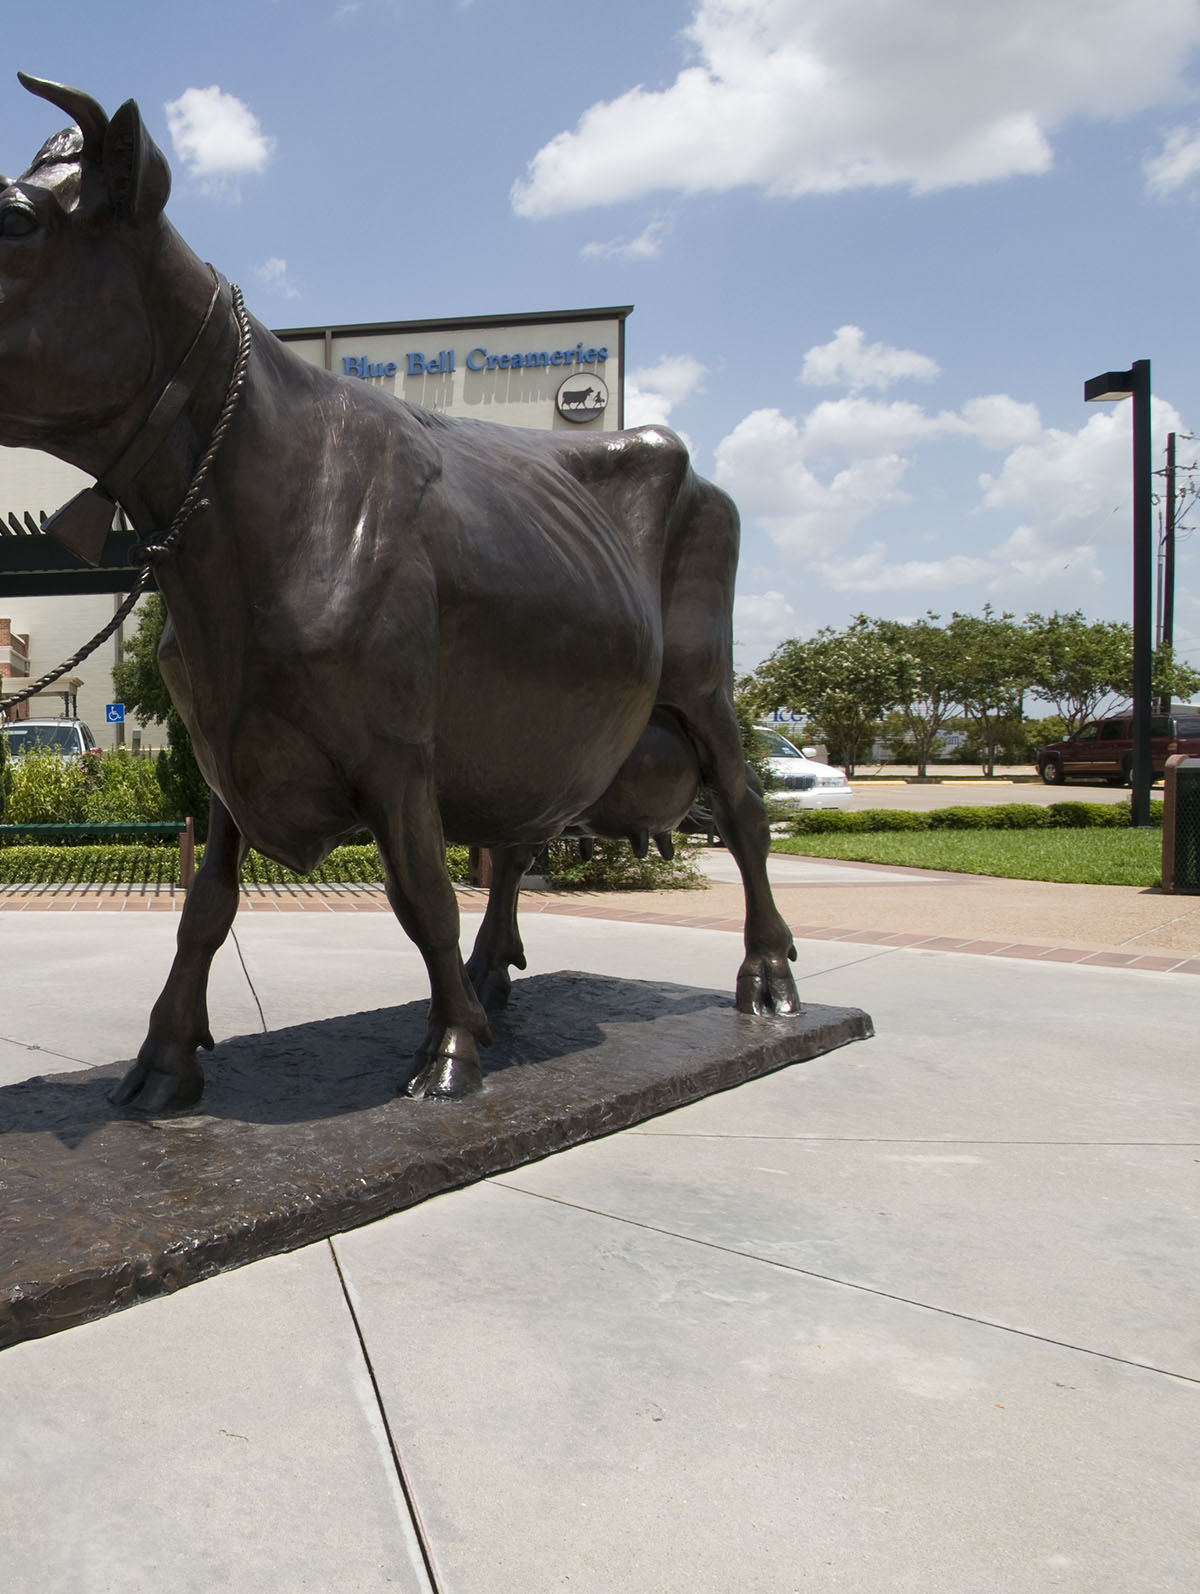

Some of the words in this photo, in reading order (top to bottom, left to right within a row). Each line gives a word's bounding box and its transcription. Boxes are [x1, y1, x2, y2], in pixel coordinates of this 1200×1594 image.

[342, 355, 398, 379] Blue
[406, 350, 455, 375] Bell
[465, 342, 609, 371] Creameries
